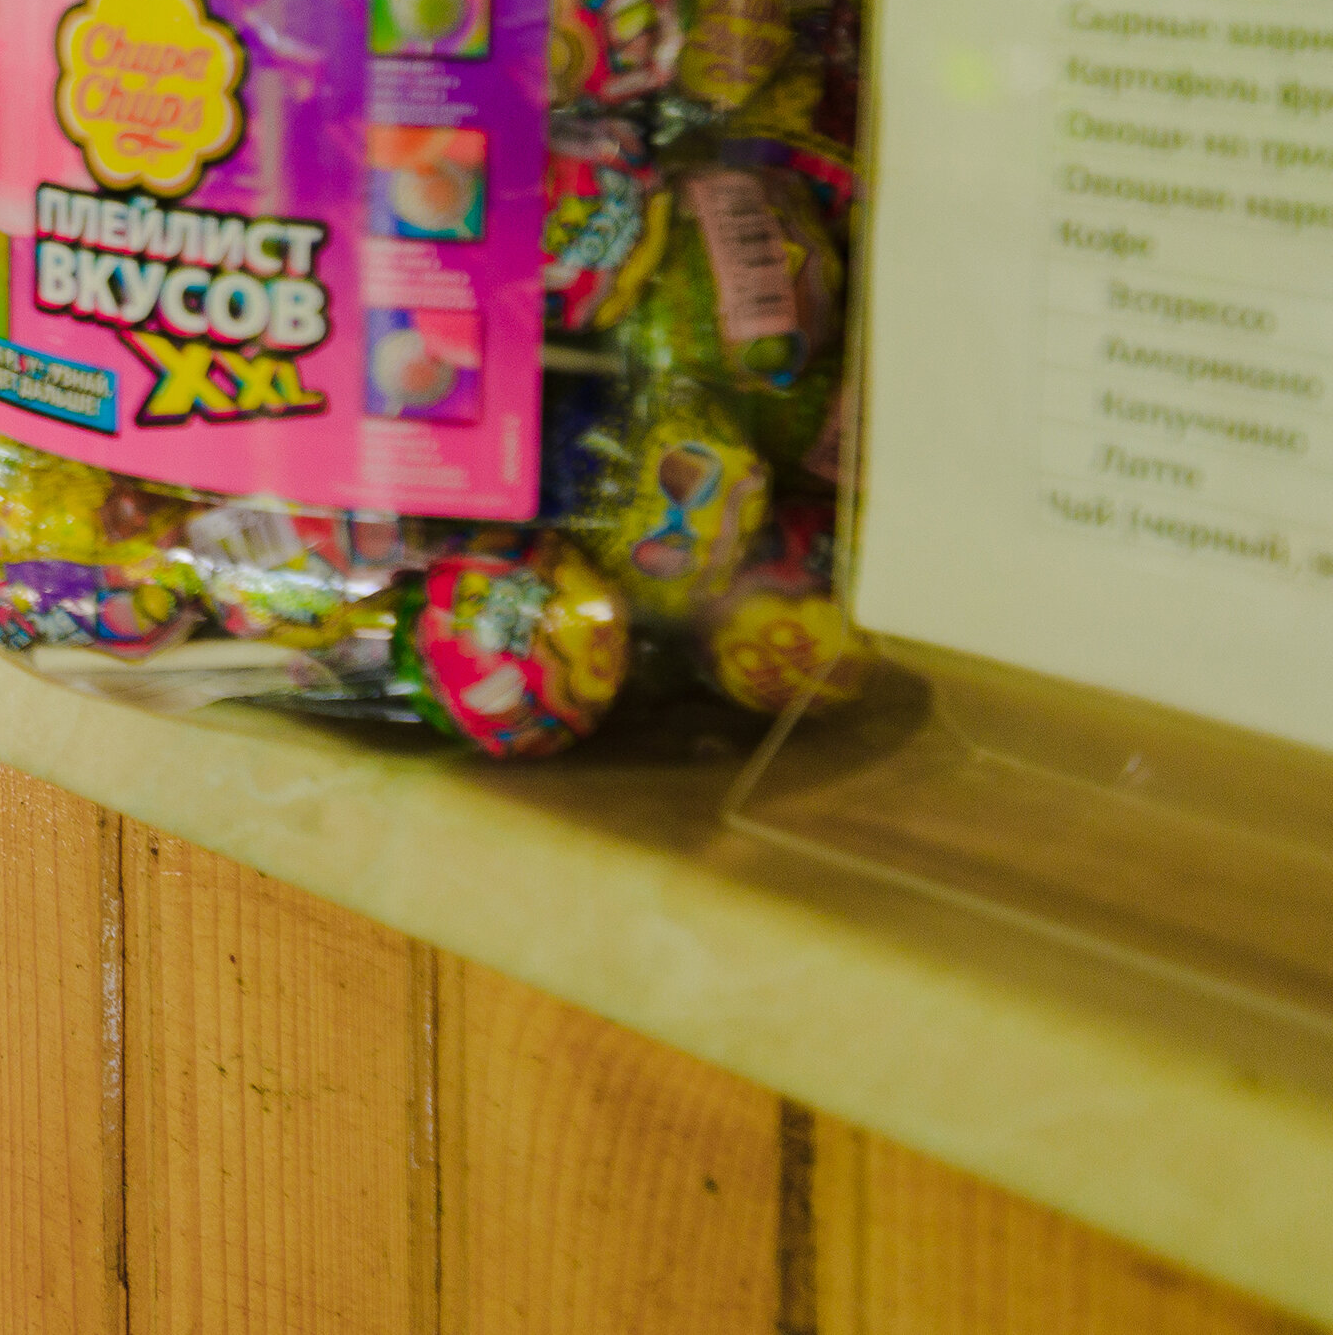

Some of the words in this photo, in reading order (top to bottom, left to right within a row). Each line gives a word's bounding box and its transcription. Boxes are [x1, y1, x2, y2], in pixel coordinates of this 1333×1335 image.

[82, 22, 213, 81] Chupa
[76, 73, 206, 145] Chups
[38, 186, 325, 276] ПЛЕЙЛИСТ
[37, 240, 328, 349] ВКУСОВ
[126, 331, 325, 417] XXL
